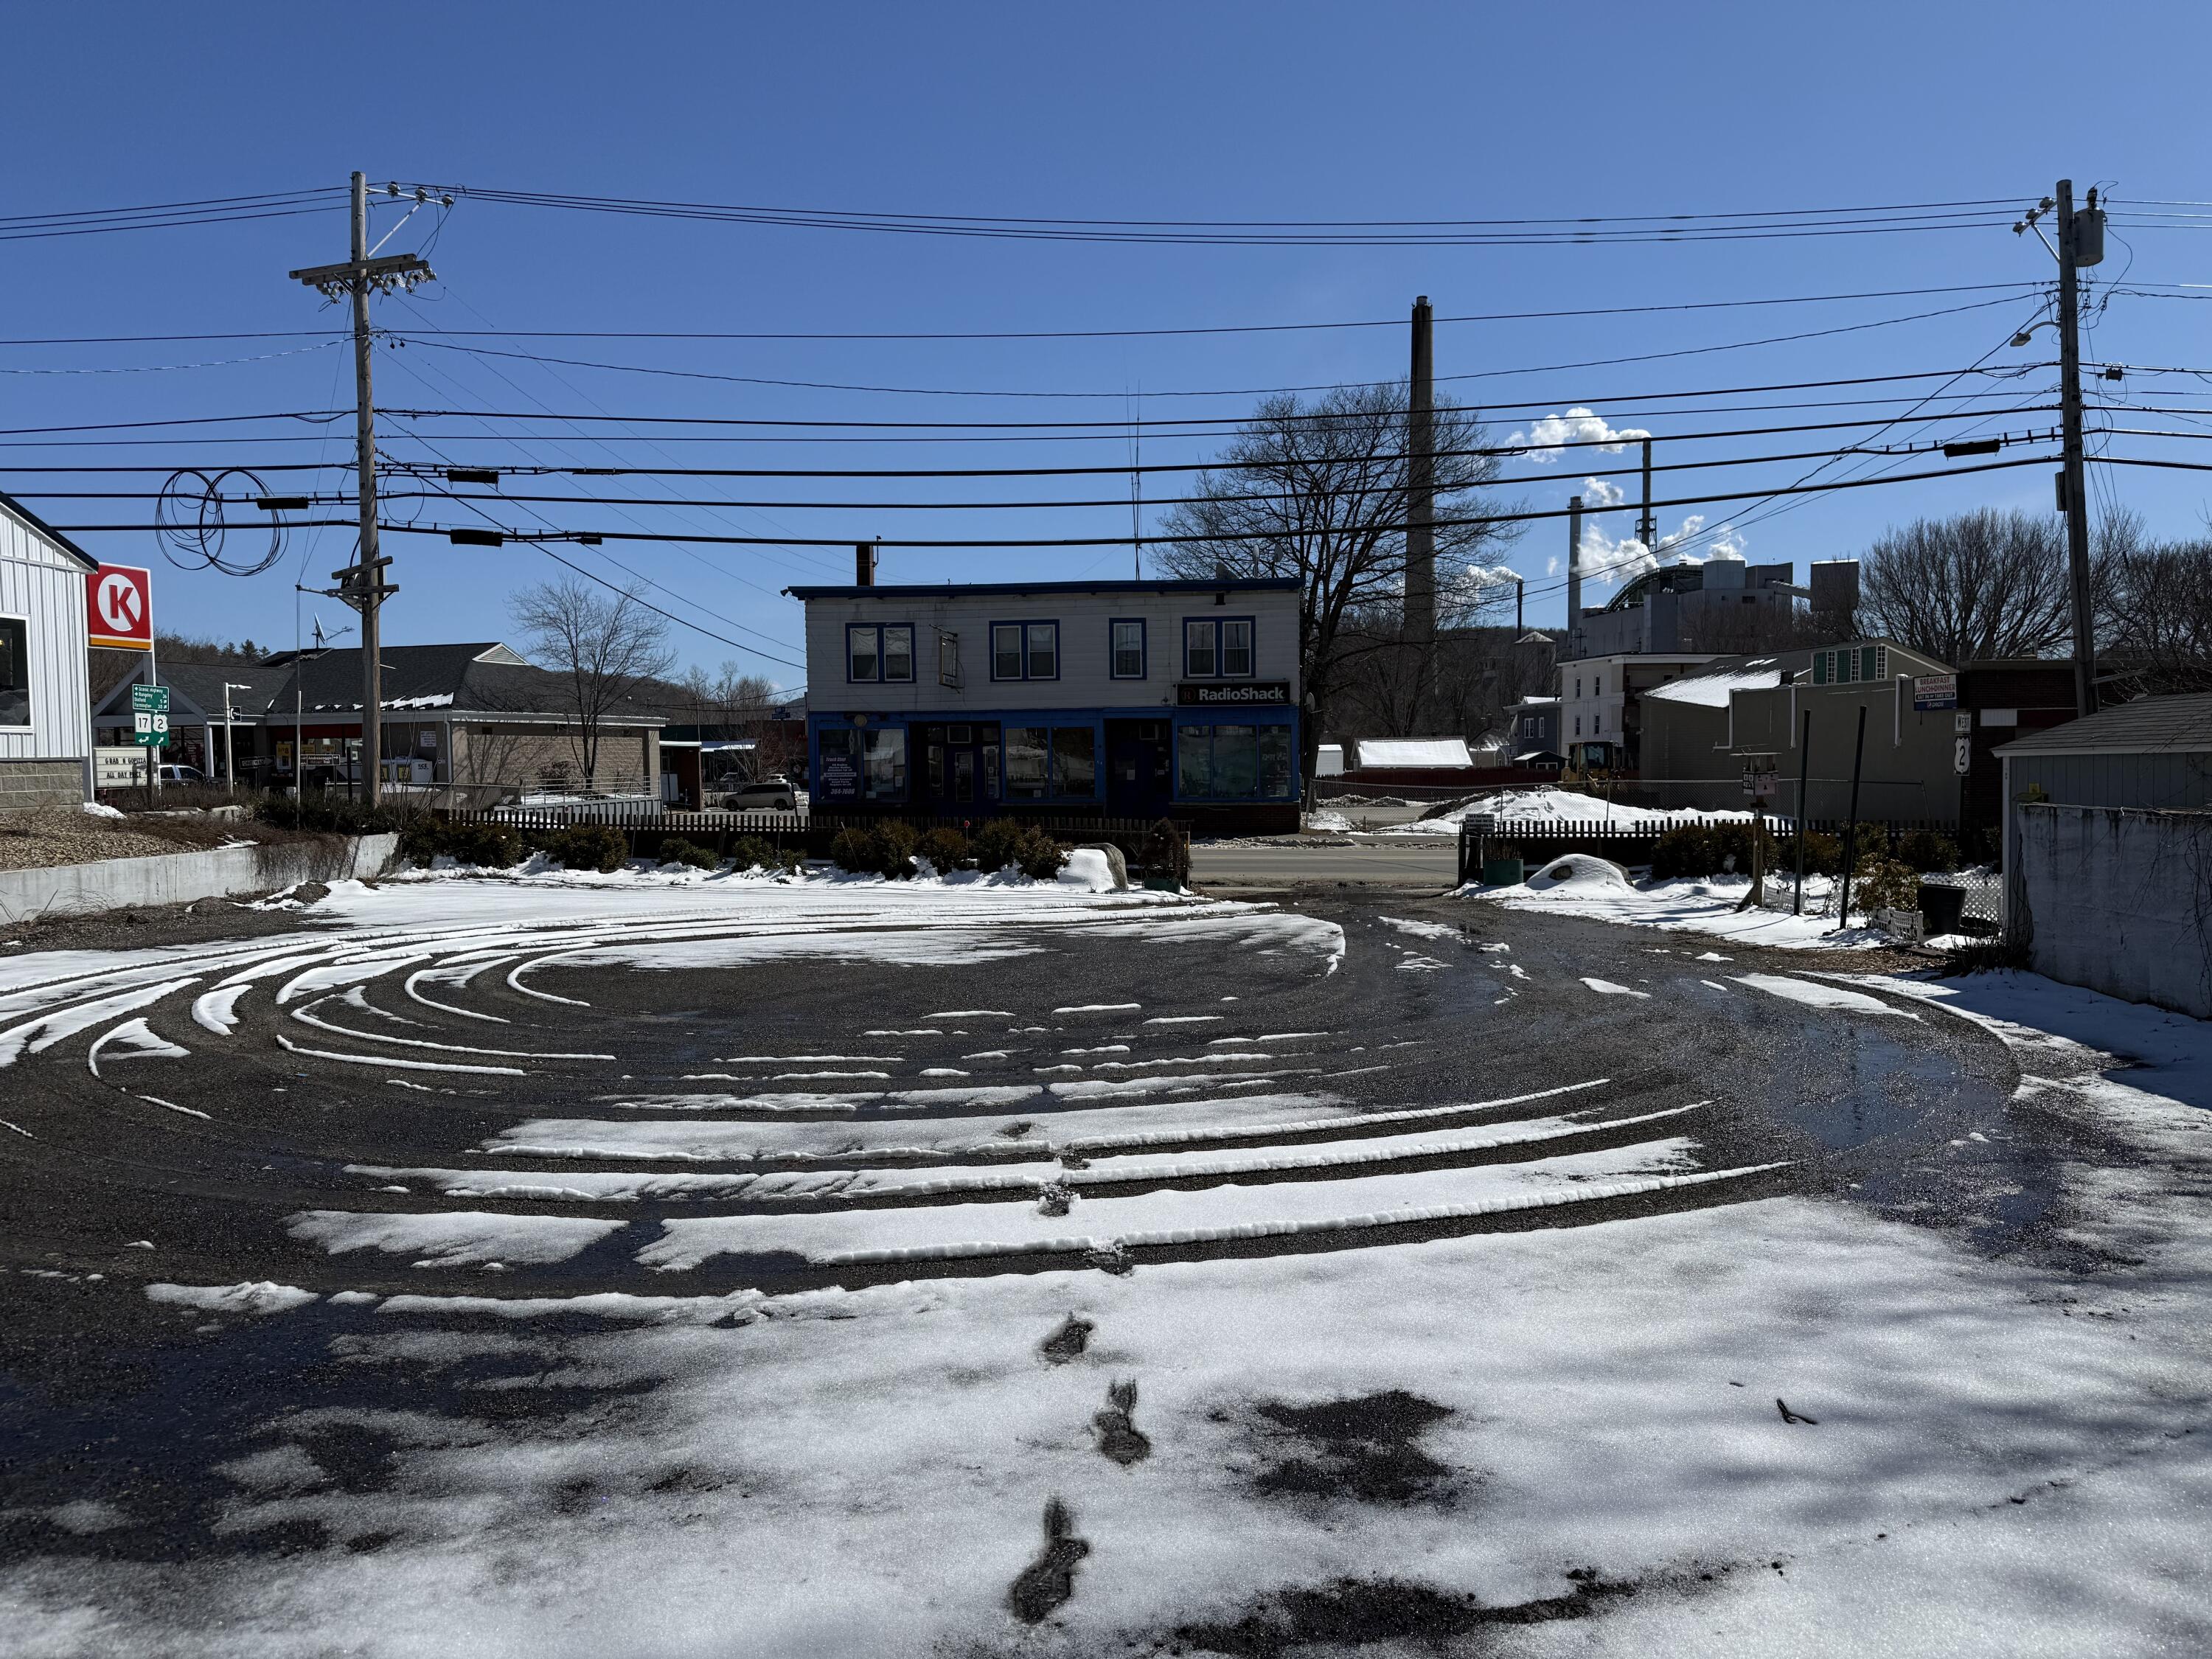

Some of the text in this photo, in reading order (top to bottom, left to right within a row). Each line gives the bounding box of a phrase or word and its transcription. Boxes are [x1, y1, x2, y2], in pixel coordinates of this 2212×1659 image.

[108, 585, 138, 627] K
[1919, 676, 1950, 686] BREAKFAST
[1199, 686, 1284, 700] RadioShack
[139, 717, 148, 728] 17
[158, 719, 163, 729] 2
[1958, 716, 1969, 728] WEST
[1959, 745, 1966, 766] 2
